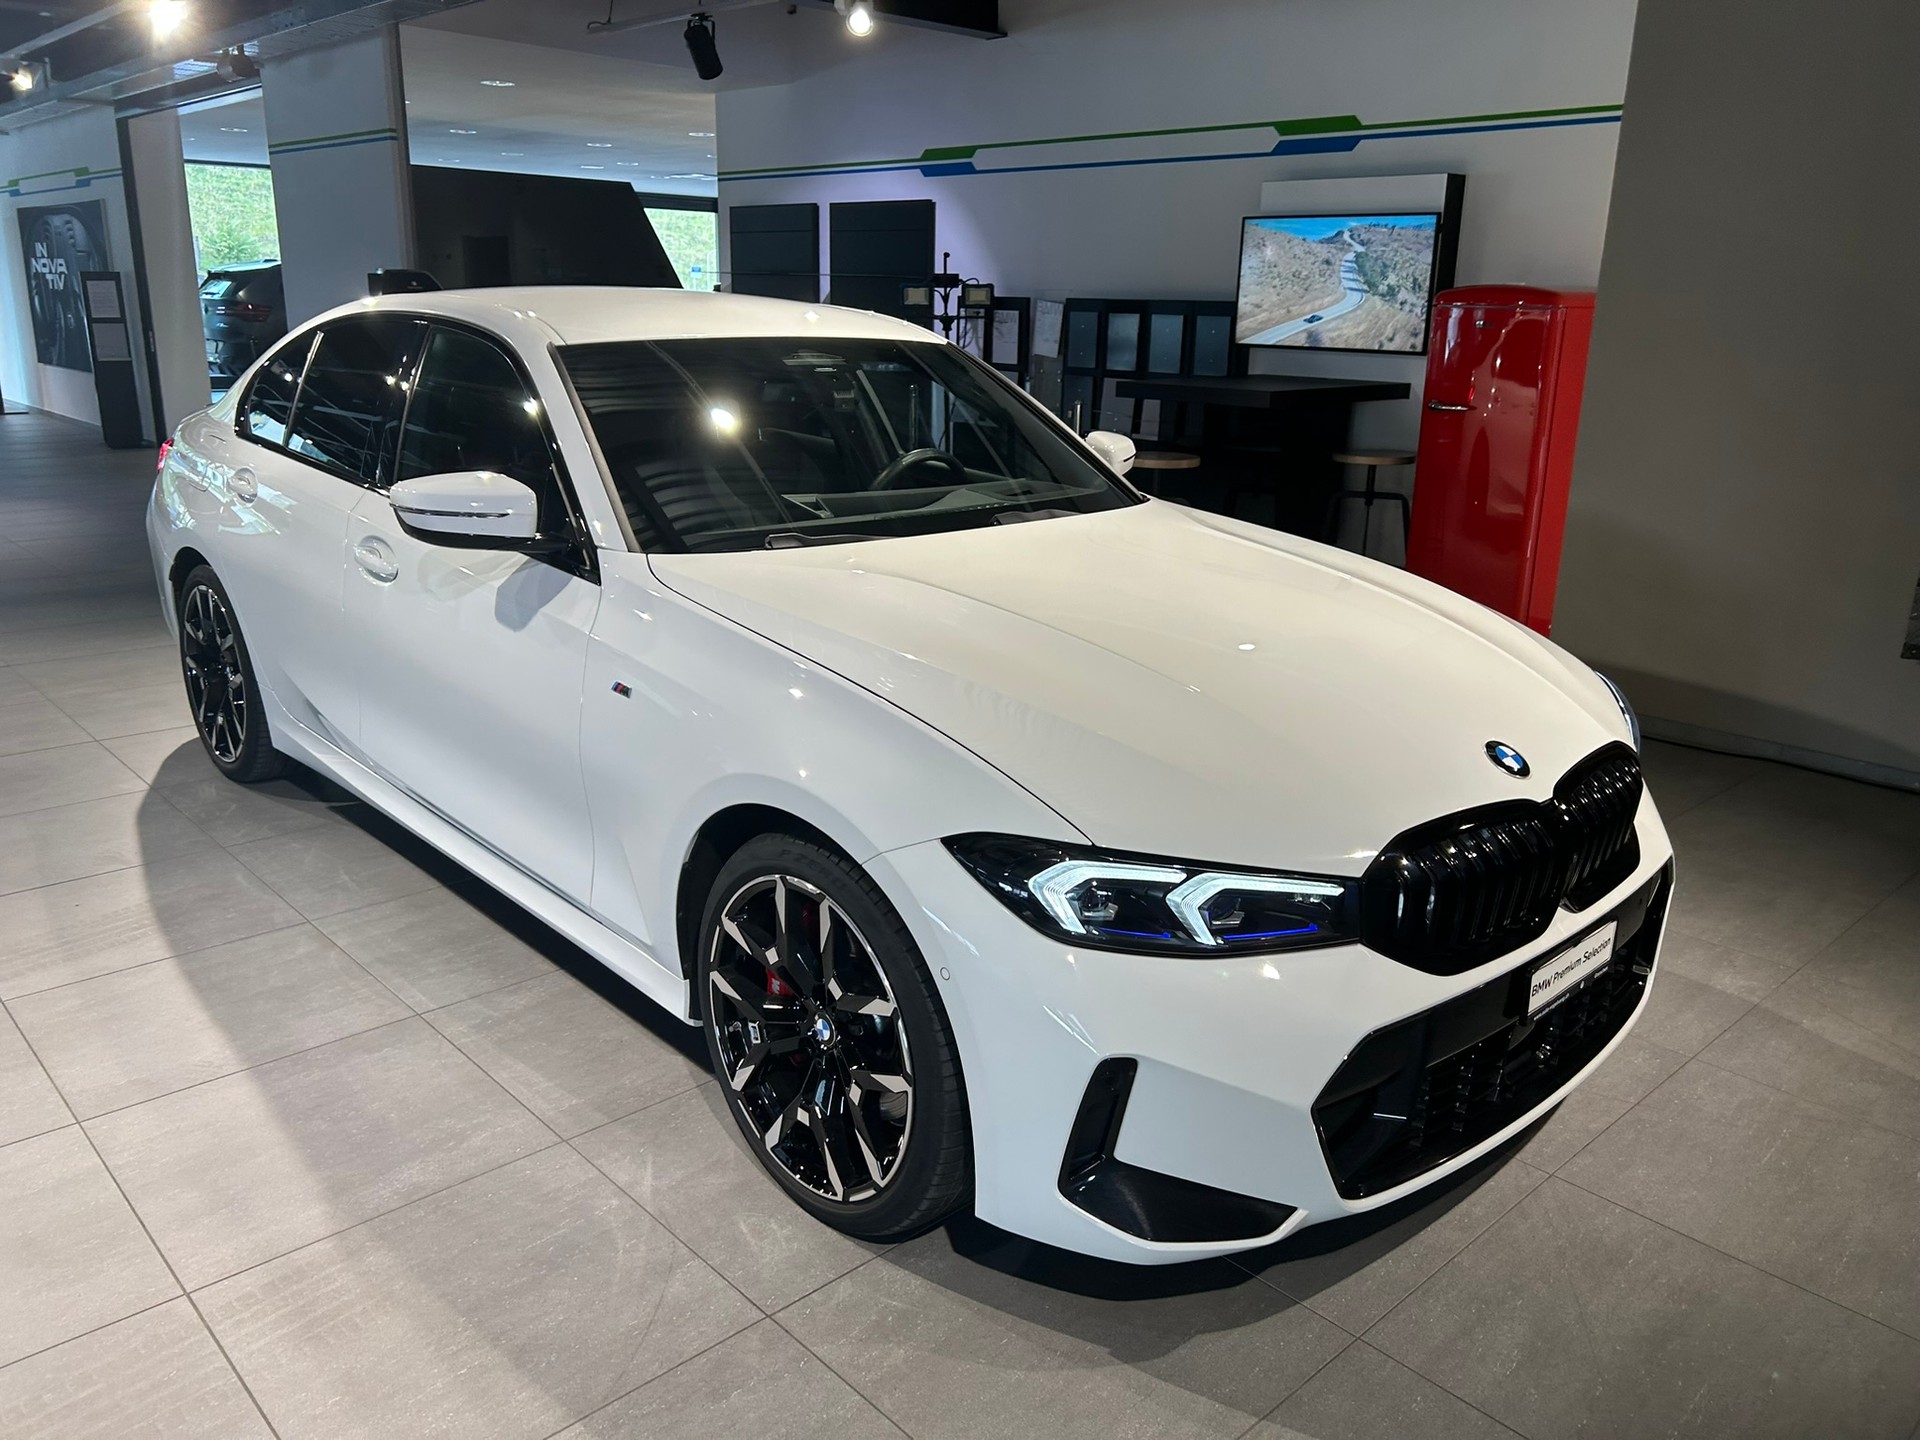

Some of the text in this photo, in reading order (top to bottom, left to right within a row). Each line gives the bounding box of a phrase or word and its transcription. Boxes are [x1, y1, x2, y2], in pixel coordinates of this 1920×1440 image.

[35, 242, 48, 258] IN
[31, 258, 68, 274] NOVA
[45, 273, 65, 290] TIV
[1531, 975, 1553, 997] BMW
[1553, 957, 1582, 985] Premium
[1582, 937, 1611, 964] Selection
